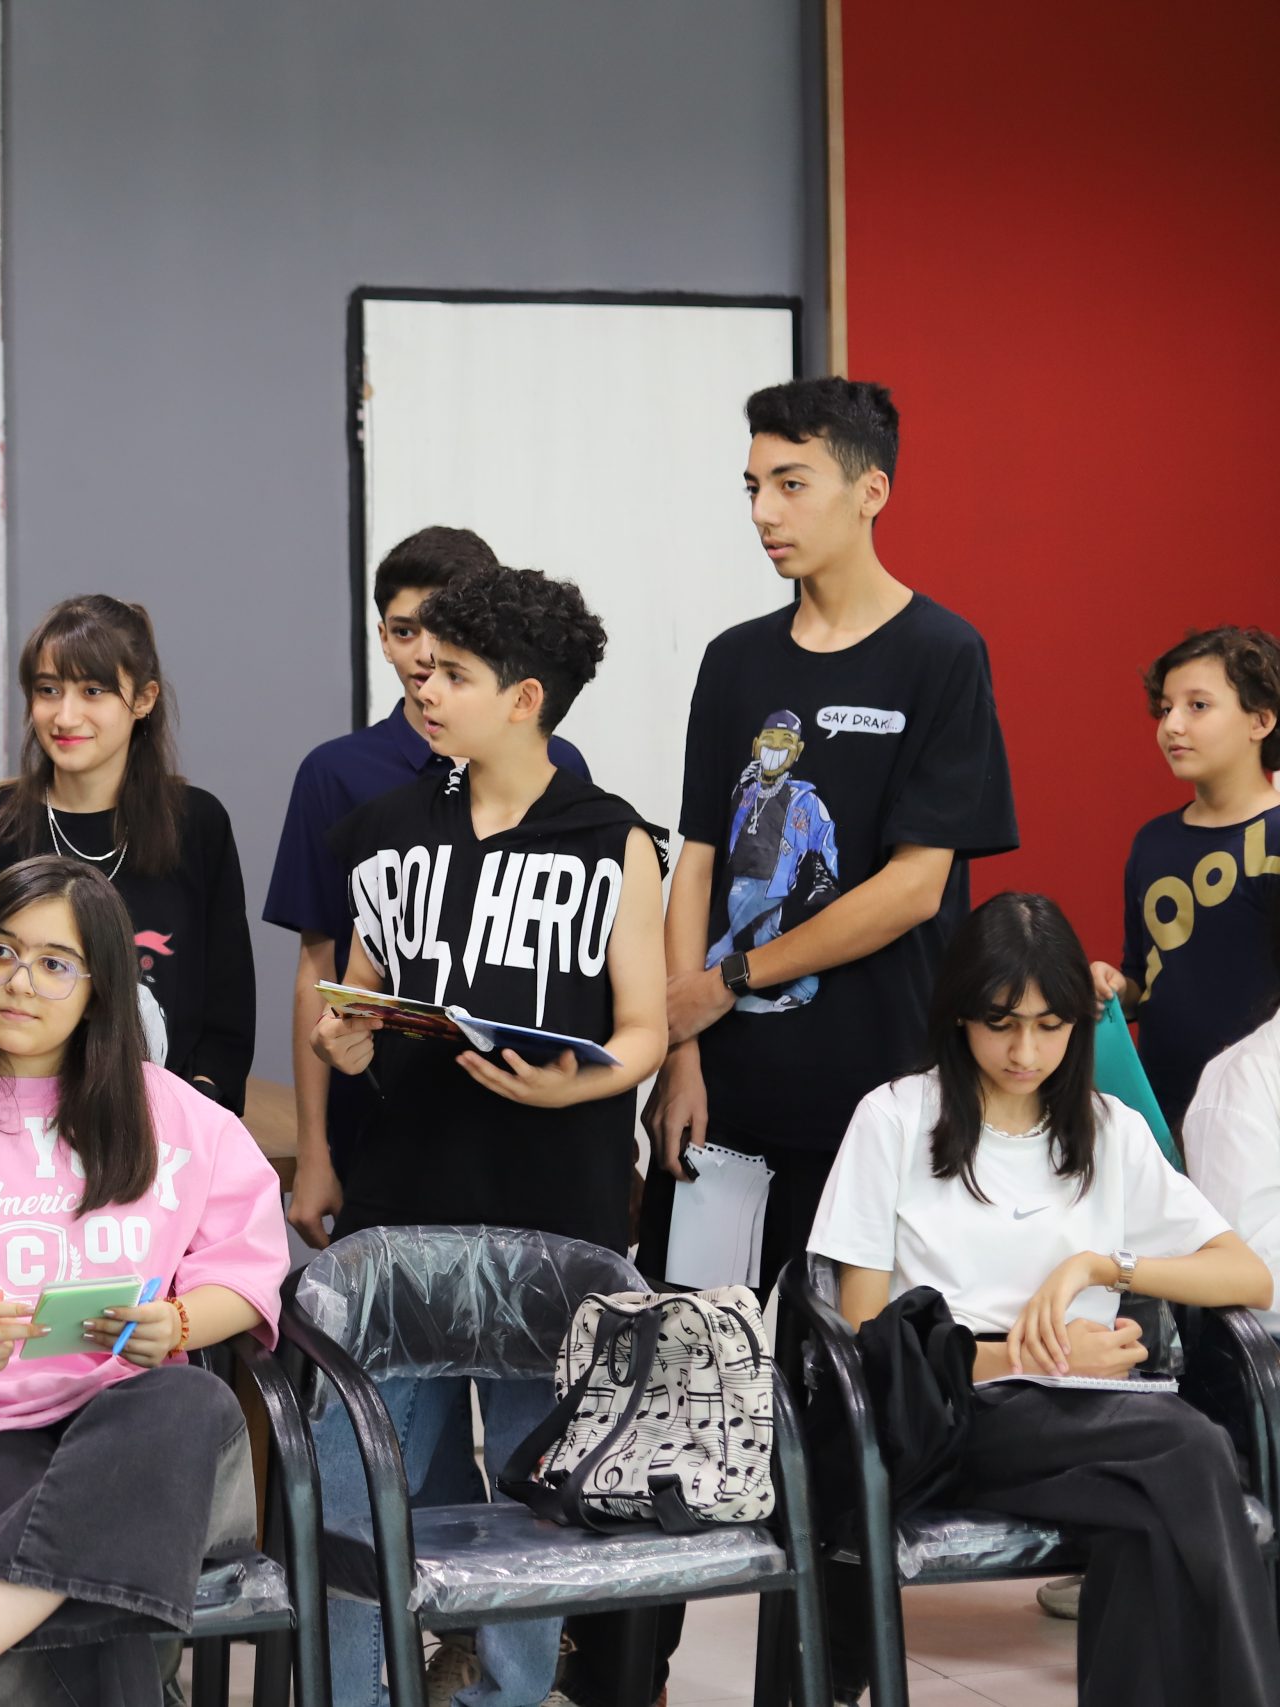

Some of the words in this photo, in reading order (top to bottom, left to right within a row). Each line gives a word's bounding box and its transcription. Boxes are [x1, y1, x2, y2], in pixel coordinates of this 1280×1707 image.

[821, 712, 848, 724] SAY
[462, 849, 623, 1027] HERO
[6, 1235, 45, 1287] C
